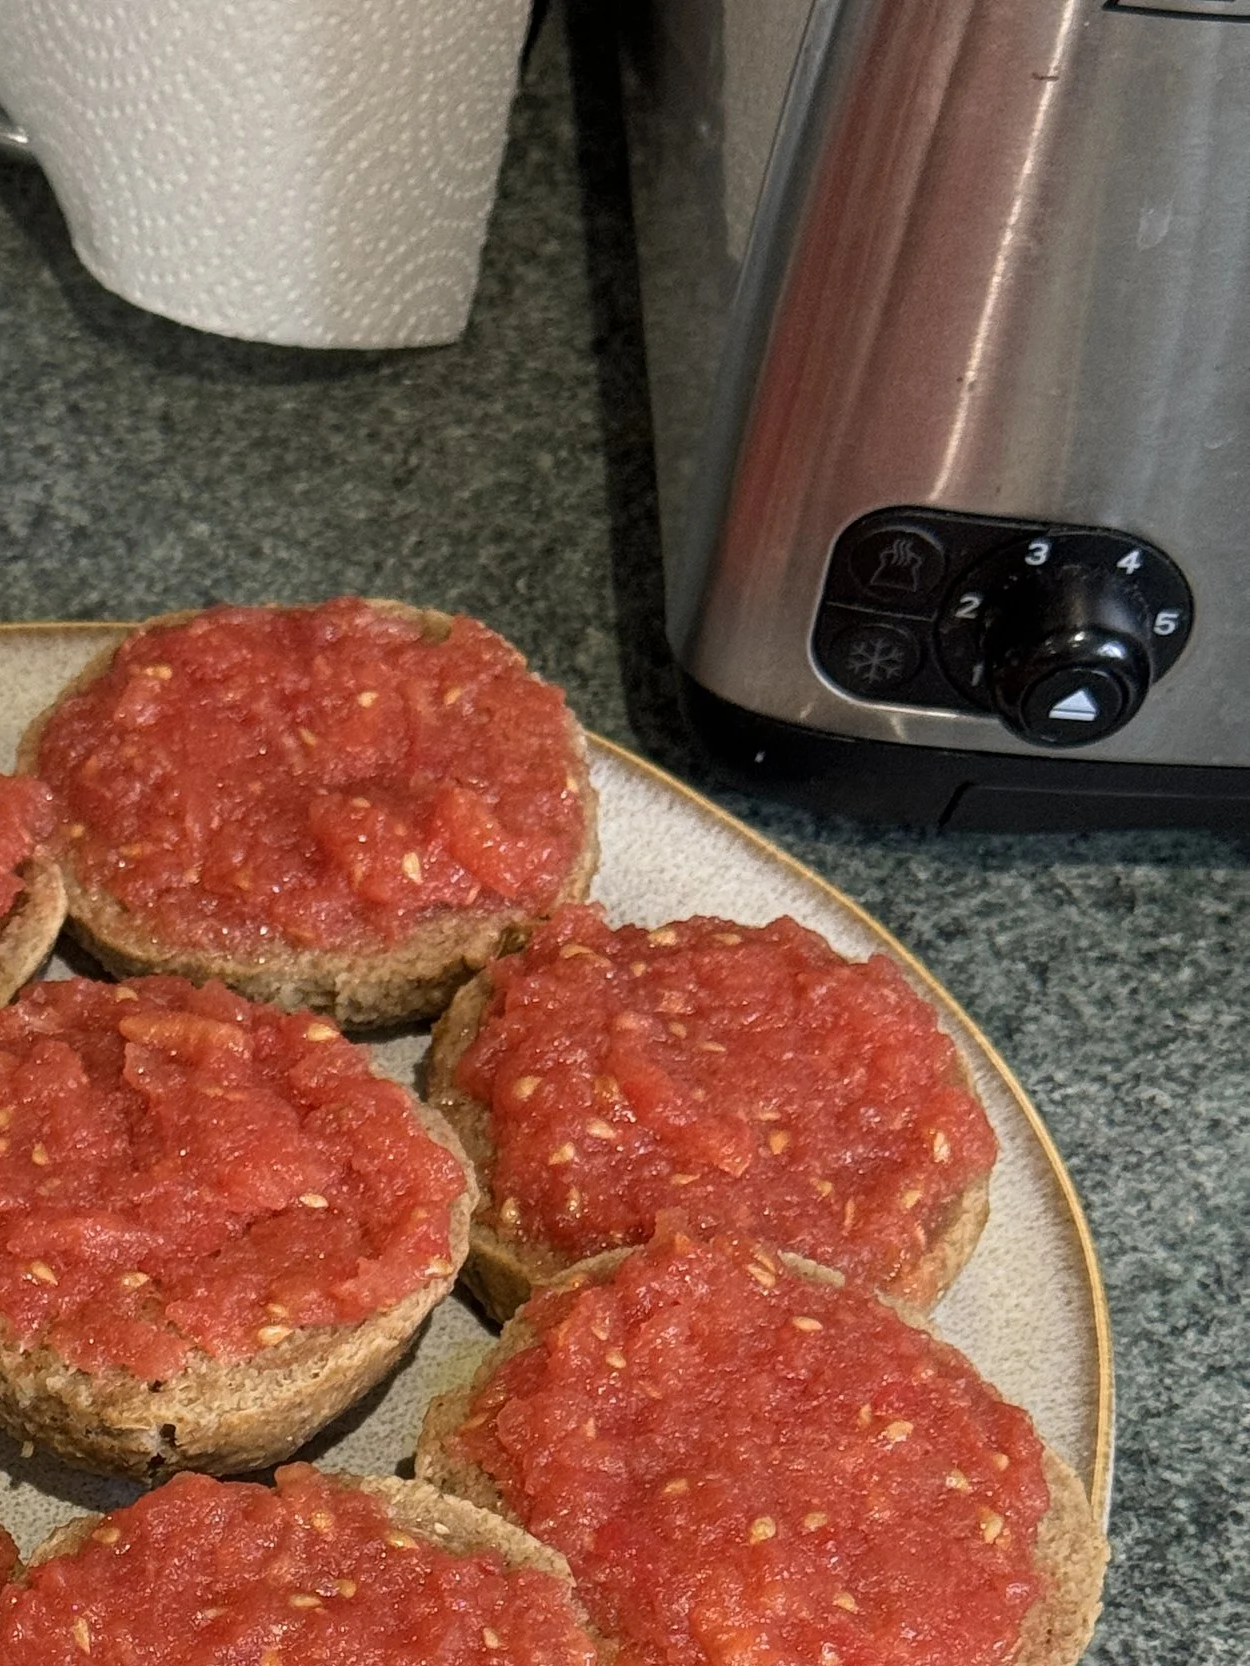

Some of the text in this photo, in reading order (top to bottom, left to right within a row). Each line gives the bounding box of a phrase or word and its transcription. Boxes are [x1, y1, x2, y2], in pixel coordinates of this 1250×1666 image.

[1025, 542, 1050, 565] 3
[1117, 550, 1141, 574] 4
[955, 596, 982, 619] 2
[1154, 611, 1179, 635] 5
